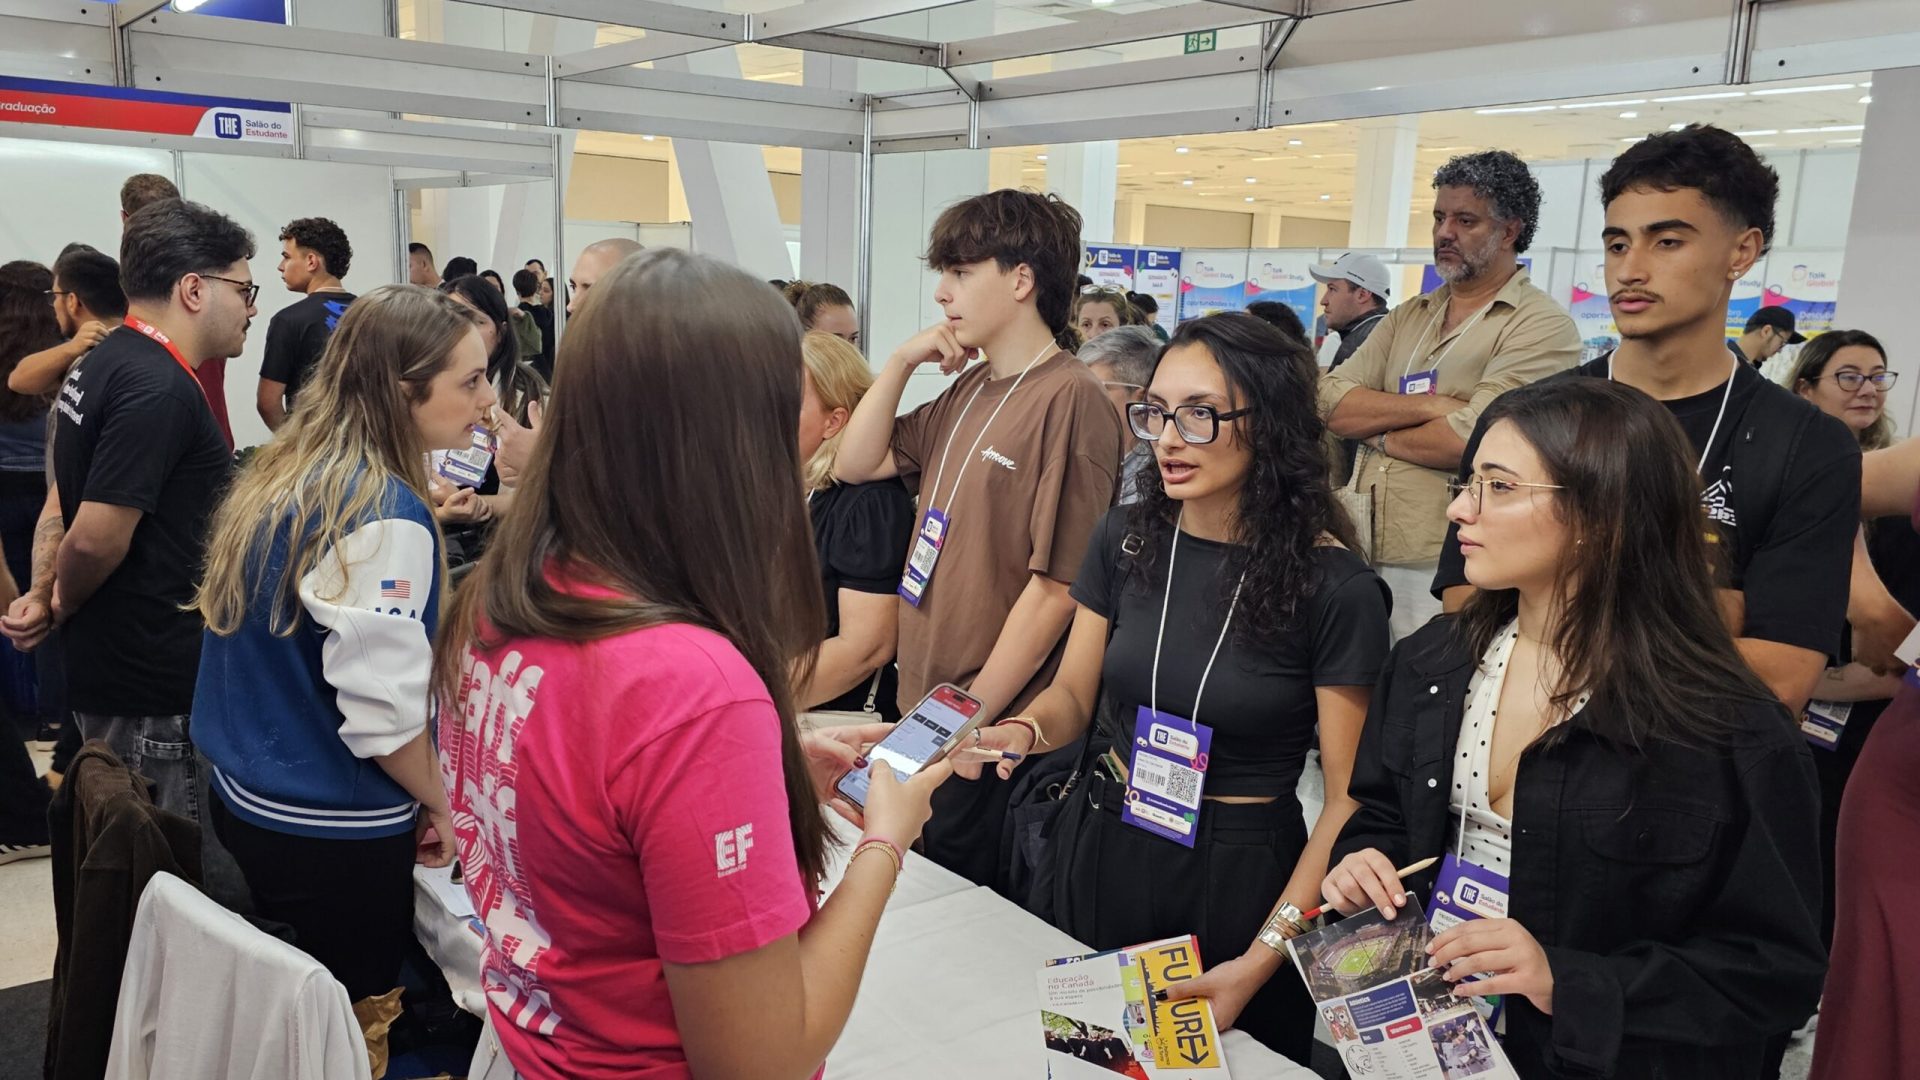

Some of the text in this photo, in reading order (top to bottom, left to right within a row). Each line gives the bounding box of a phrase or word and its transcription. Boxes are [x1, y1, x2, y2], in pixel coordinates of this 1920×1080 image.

[0, 101, 56, 115] raduação
[218, 117, 239, 135] THE
[245, 120, 282, 130] Salão do
[245, 128, 288, 139] Estudante
[715, 822, 754, 870] EF
[1462, 886, 1477, 902] THE
[1481, 893, 1495, 904] Salão
[1047, 974, 1089, 984] Educação
[1061, 979, 1094, 989] Canadá
[1159, 946, 1208, 1065] FUURE
